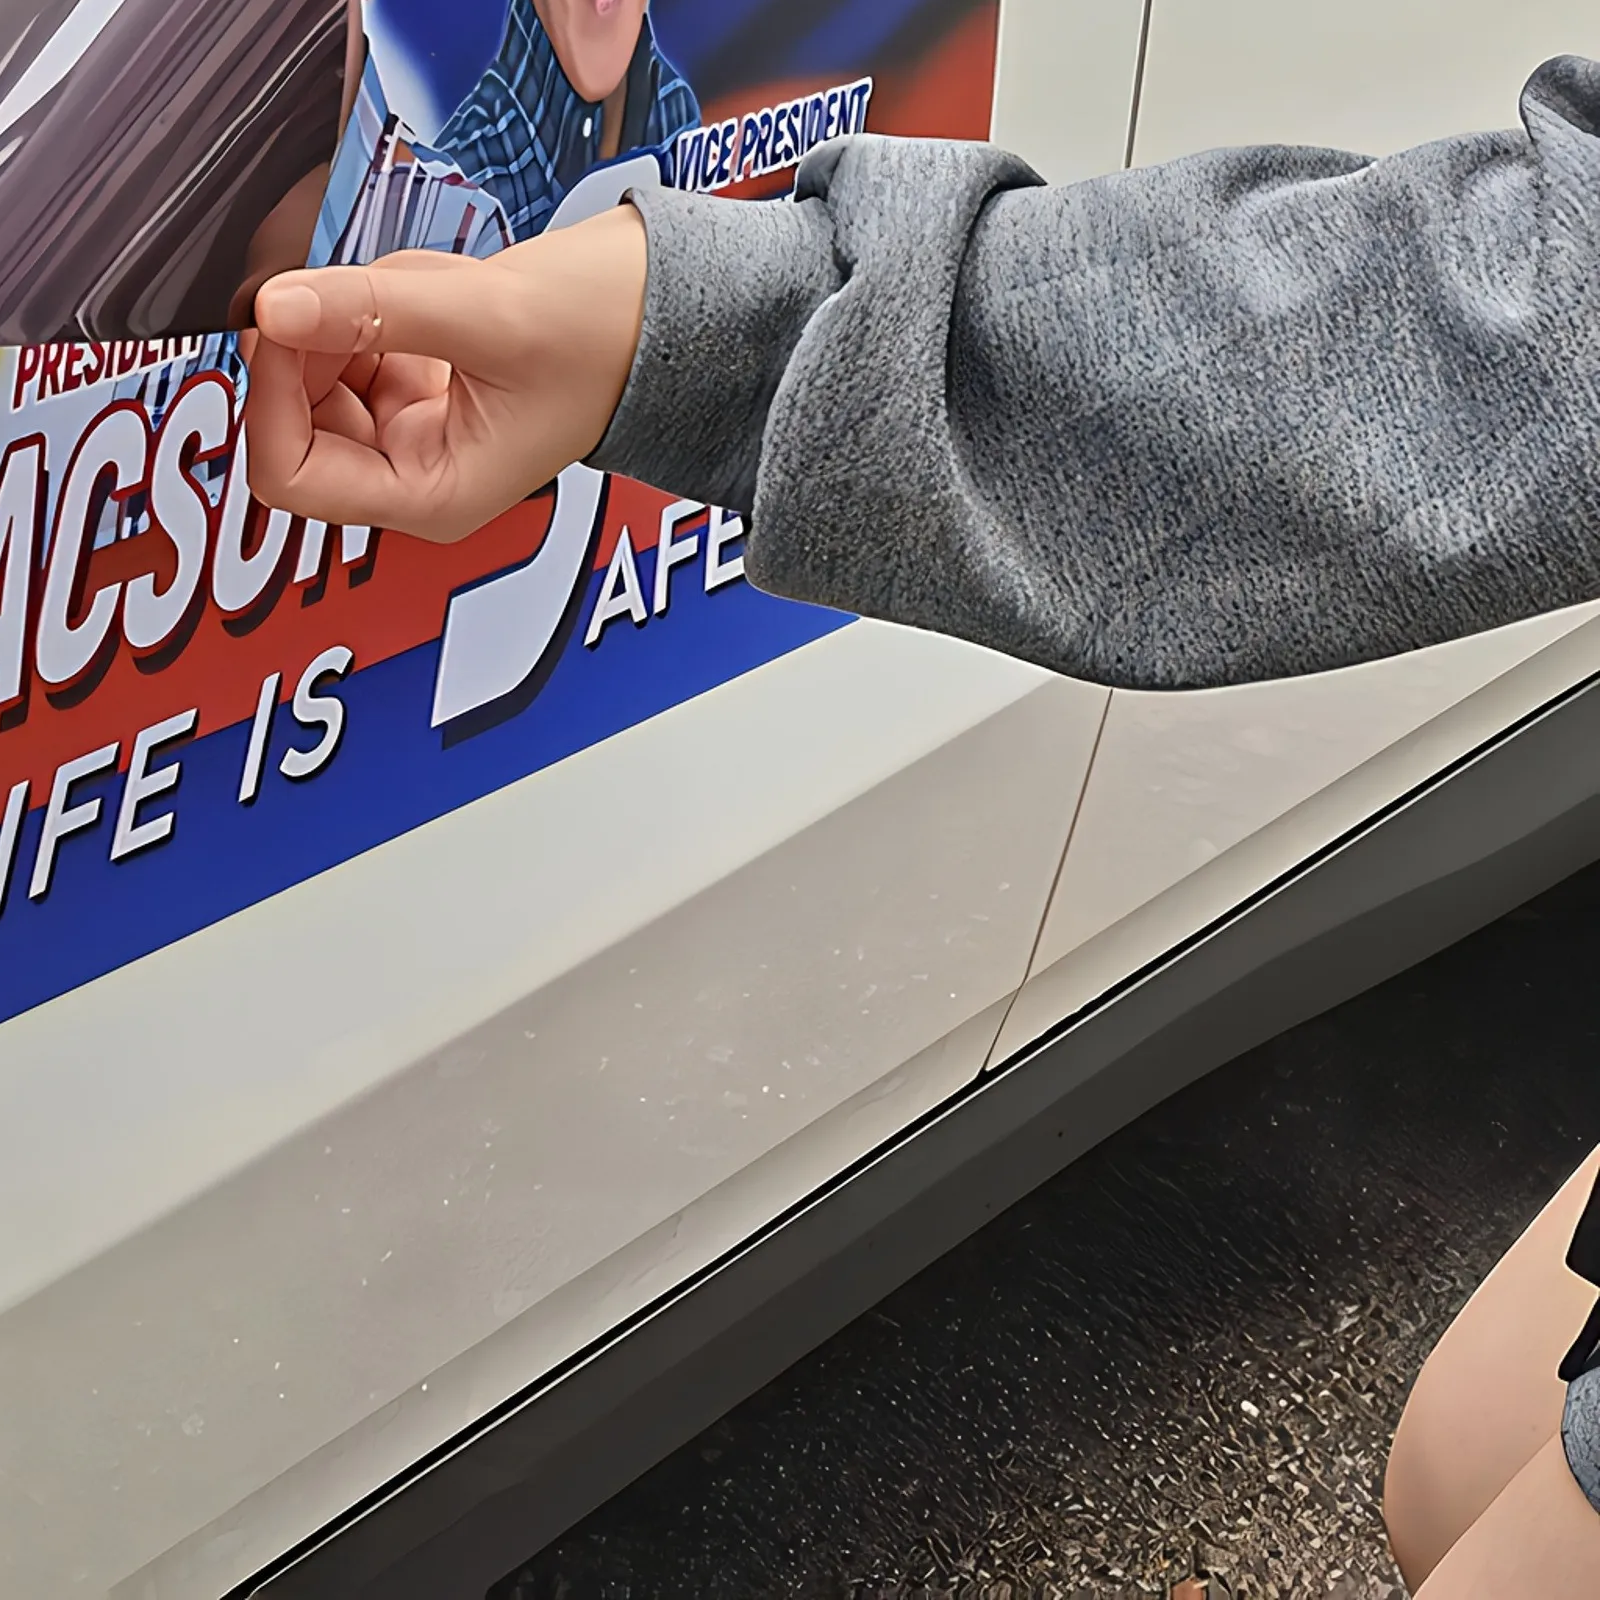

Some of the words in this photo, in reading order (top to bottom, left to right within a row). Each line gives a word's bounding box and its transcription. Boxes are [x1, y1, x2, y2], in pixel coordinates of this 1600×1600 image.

[678, 122, 736, 190] VICE
[738, 79, 871, 177] PRESIDENT
[238, 644, 354, 803] IS
